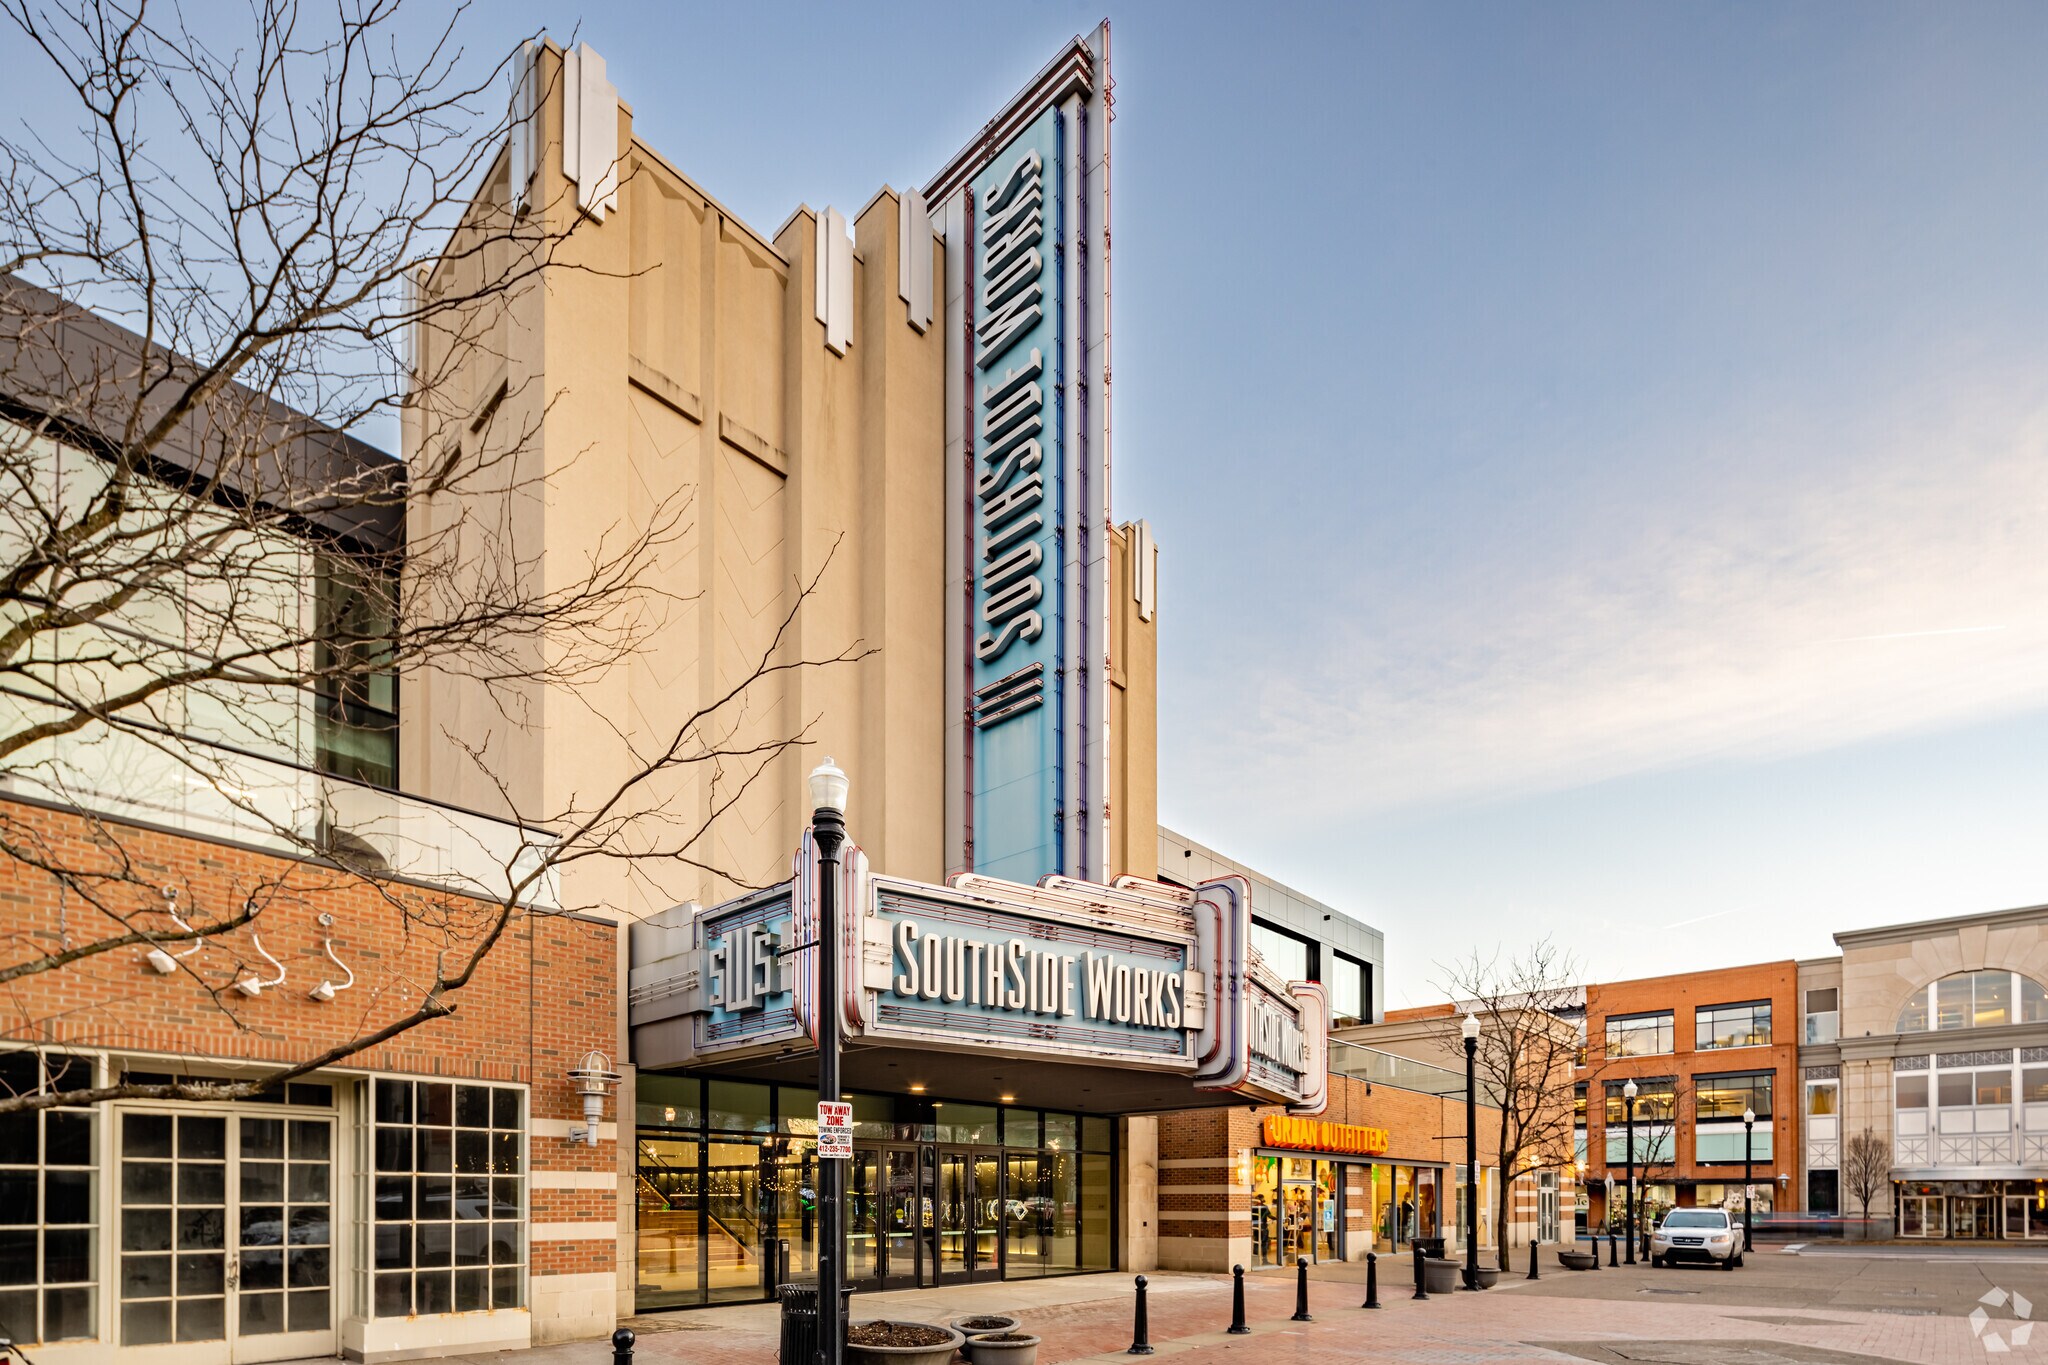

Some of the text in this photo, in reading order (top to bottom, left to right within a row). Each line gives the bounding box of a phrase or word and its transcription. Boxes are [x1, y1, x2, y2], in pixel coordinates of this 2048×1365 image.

[976, 148, 1043, 663] SOUTHSIDE WORKS
[896, 919, 1181, 1030] SOUTHSIDE WORKS
[819, 1104, 851, 1116] TOW AWAY
[826, 1115, 844, 1126] ZONE
[818, 1126, 852, 1135] TOWING ENFORCED
[1269, 1113, 1389, 1153] URBAN OUTFITTERS
[1574, 1197, 1588, 1206] le
